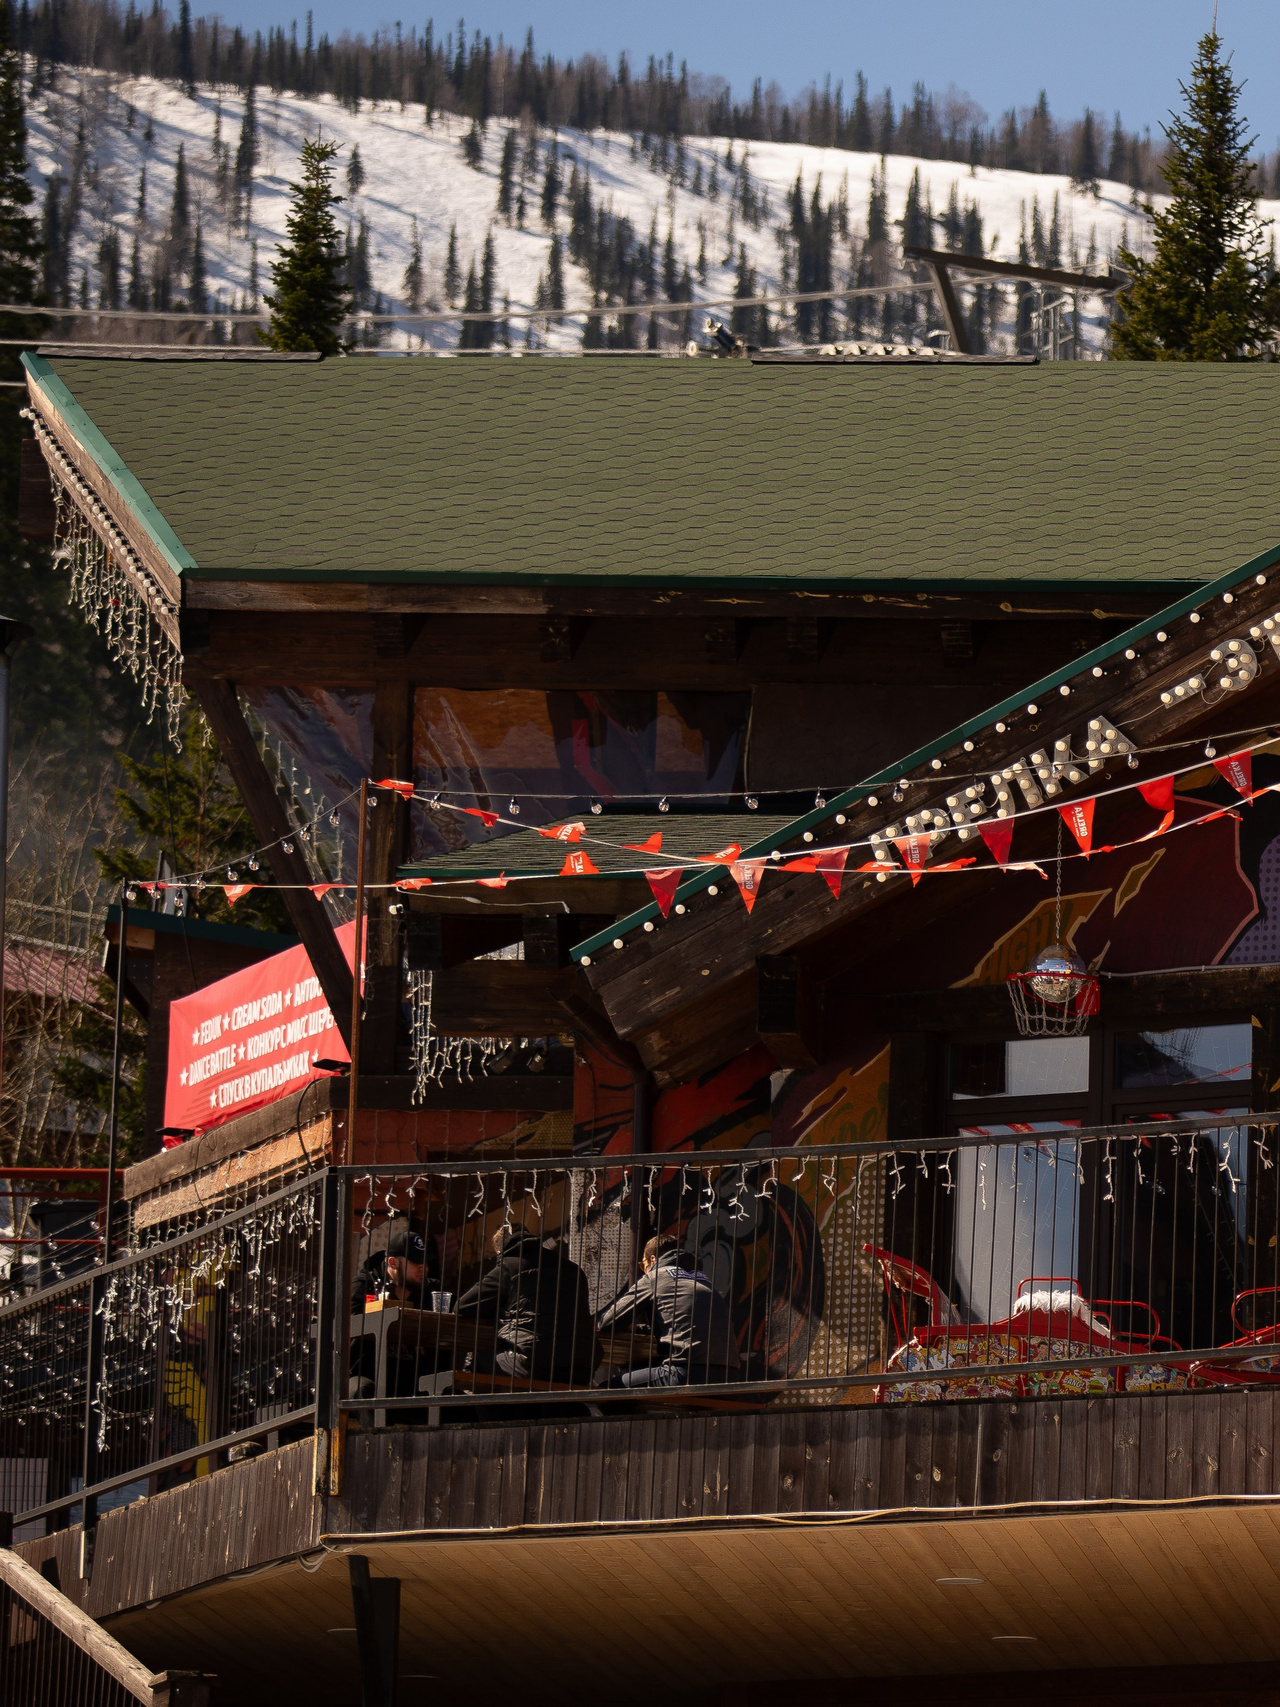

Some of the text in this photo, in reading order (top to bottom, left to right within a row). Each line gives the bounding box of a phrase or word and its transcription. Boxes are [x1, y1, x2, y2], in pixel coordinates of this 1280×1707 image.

[200, 1014, 222, 1046] FEDUK
[231, 996, 260, 1031] CREAM
[260, 990, 282, 1021] SODA
[189, 1055, 211, 1087] DANCE
[210, 1044, 236, 1077] BATTLE
[247, 1024, 287, 1061] КОНКУРС
[286, 1014, 309, 1047] МИСС
[218, 1076, 244, 1109] СПУСК
[250, 1049, 310, 1096] КУПАЛЬНИКАХ
